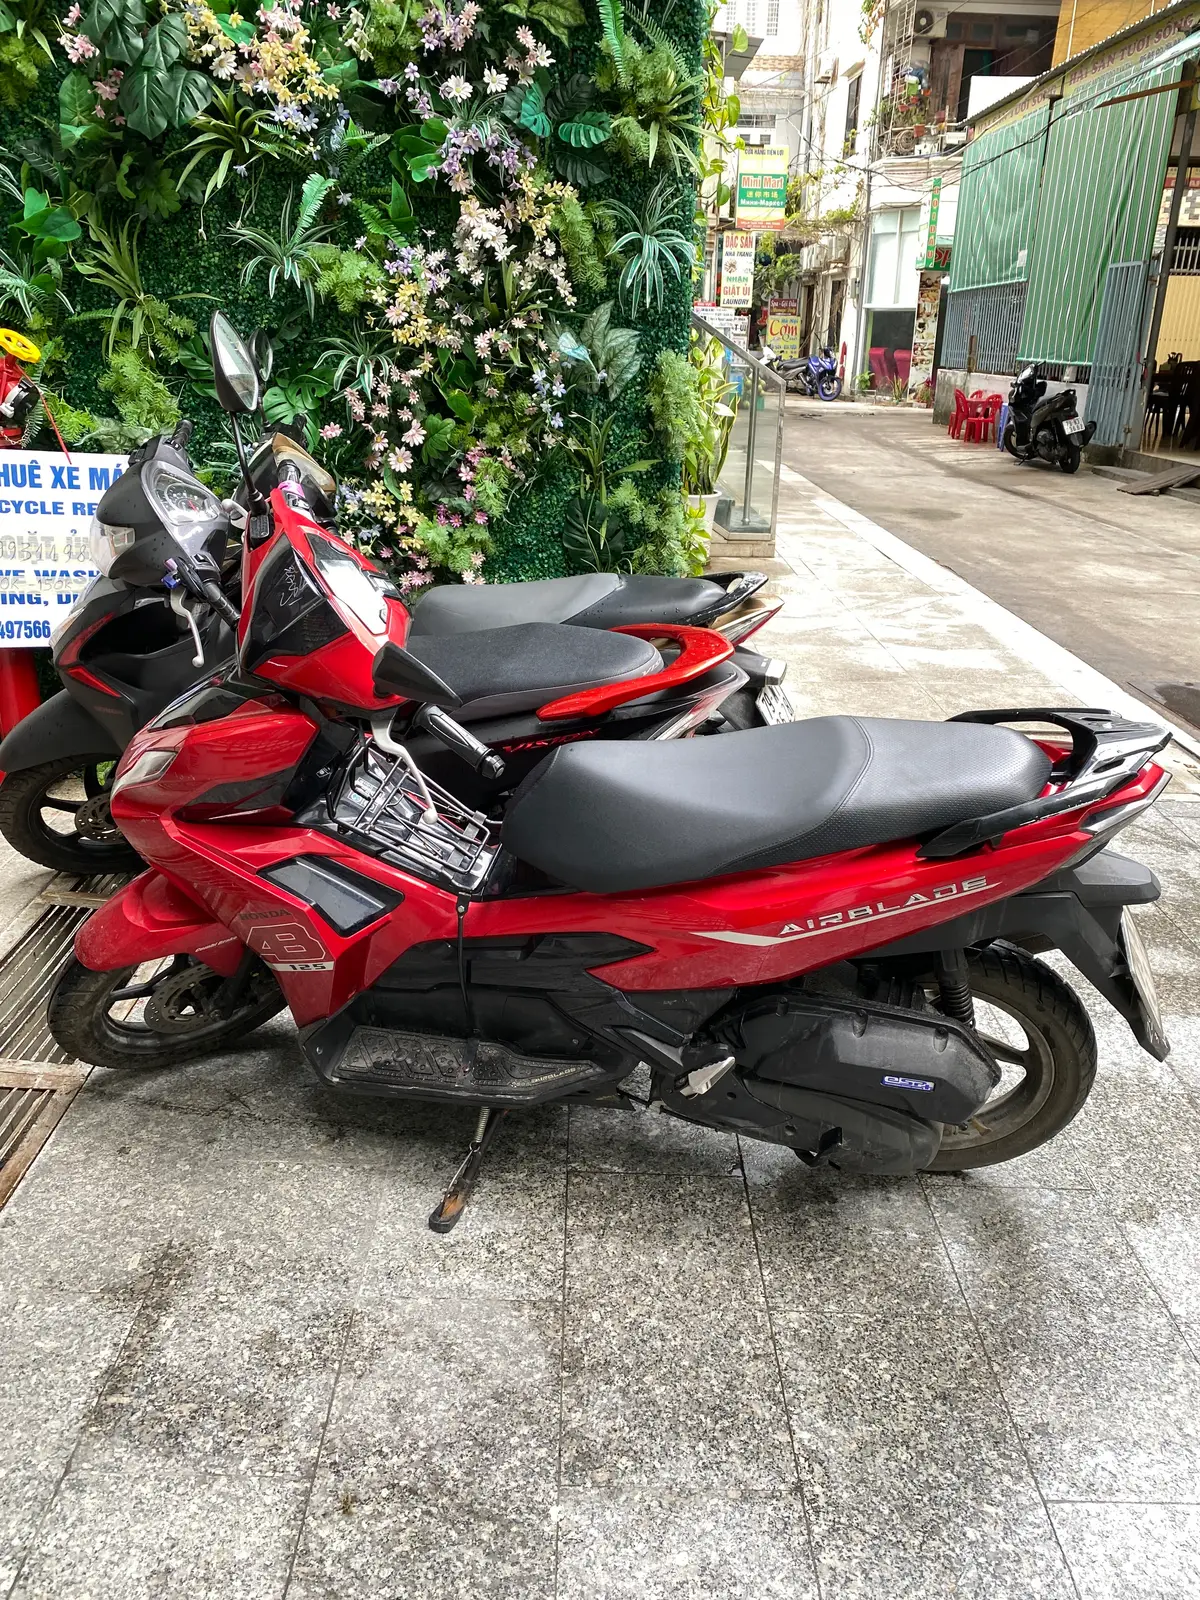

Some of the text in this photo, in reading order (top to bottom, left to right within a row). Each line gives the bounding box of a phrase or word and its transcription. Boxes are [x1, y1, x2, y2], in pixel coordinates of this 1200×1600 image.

[742, 175, 784, 190] Mini Mart
[50, 465, 81, 490] XE
[0, 500, 64, 515] CYCLE
[0, 620, 51, 639] 497566
[778, 875, 987, 936] AIRBLADE
[239, 909, 292, 921] HONDA
[289, 963, 327, 971] 125
